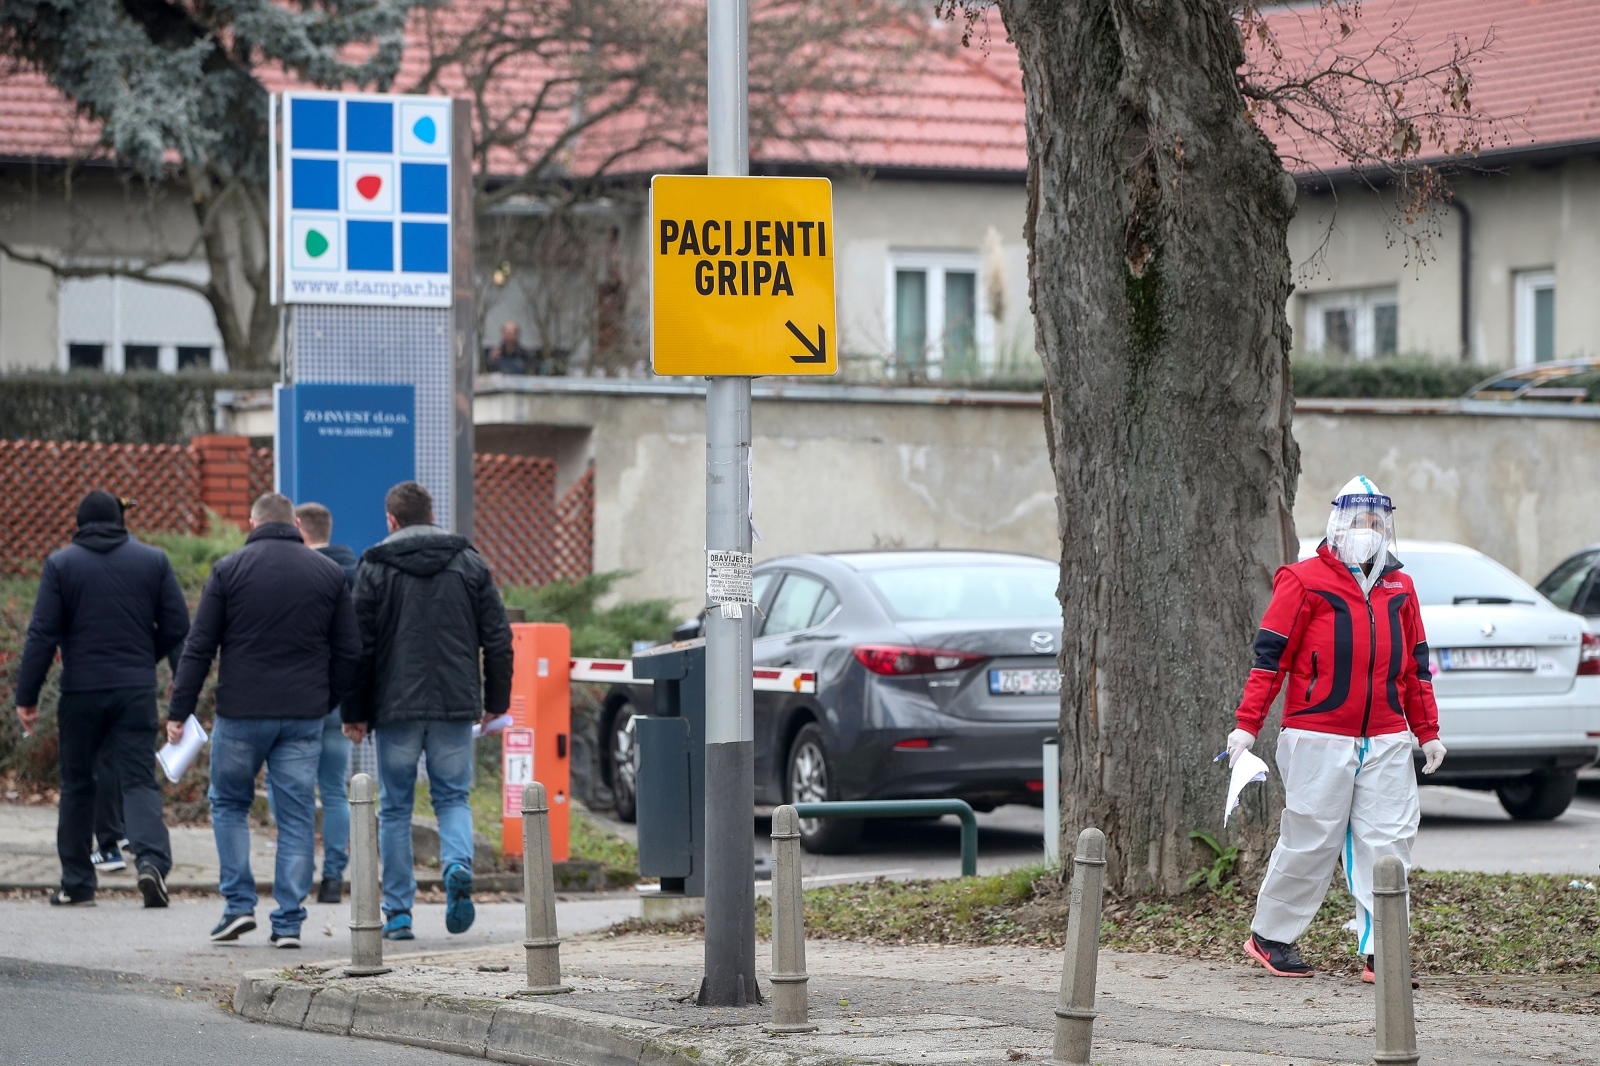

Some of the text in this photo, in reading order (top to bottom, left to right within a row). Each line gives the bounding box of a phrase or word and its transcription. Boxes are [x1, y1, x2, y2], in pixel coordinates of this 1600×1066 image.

[660, 219, 826, 257] PACIJENTI
[292, 279, 450, 298] www.stampar.hr
[695, 259, 794, 297] GRIPA
[710, 554, 746, 563] OBAVIJEST
[1002, 670, 1021, 691] ZG
